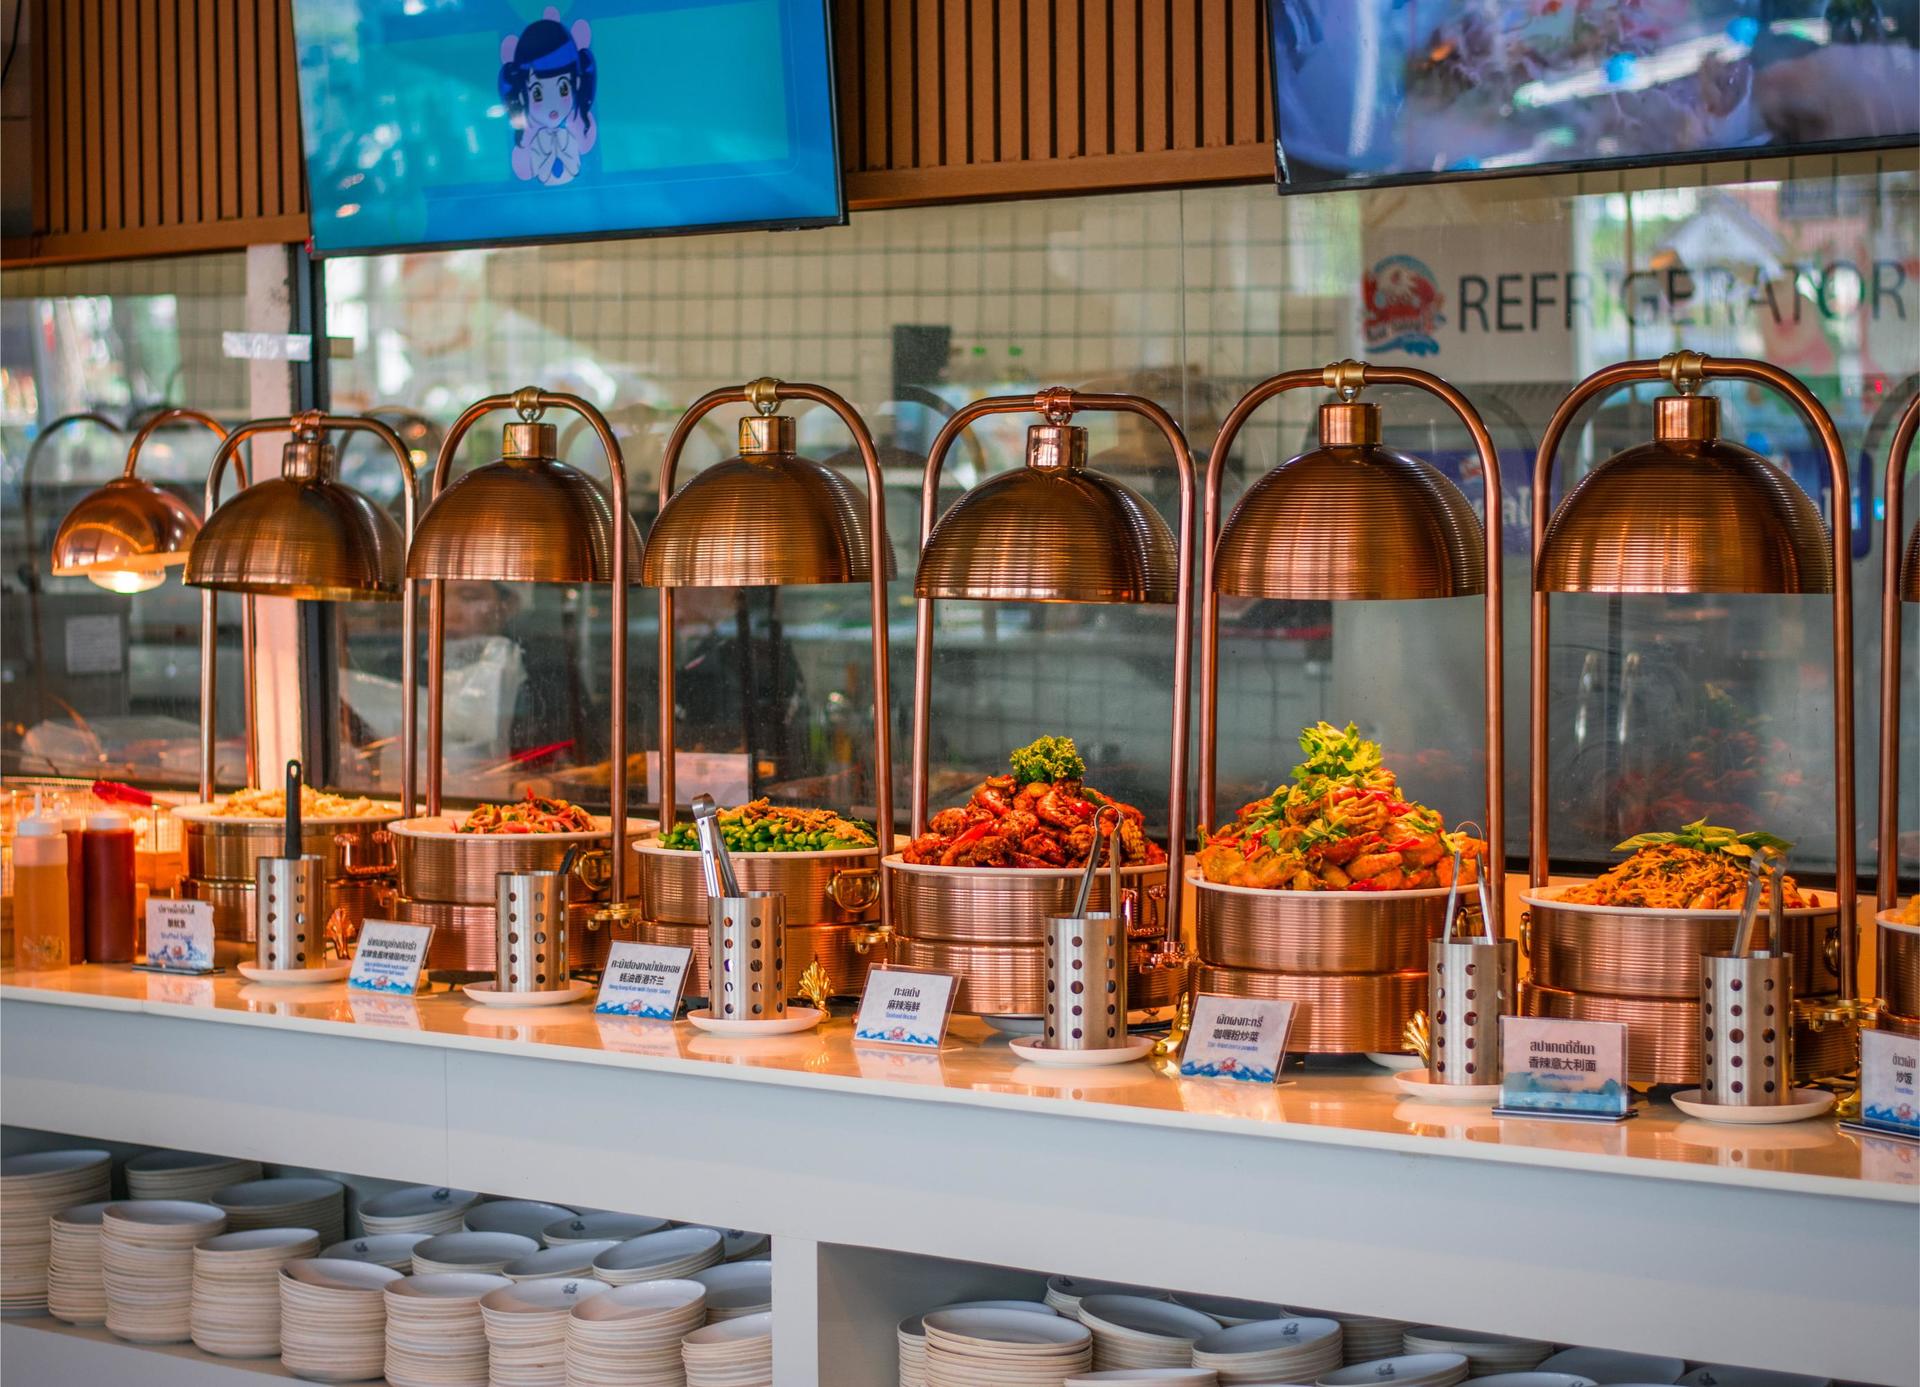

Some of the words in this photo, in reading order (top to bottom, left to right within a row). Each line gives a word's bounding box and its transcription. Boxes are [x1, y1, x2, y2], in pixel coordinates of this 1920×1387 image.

[886, 999, 921, 1012] 麻辣海鲜
[1528, 1056, 1597, 1072] 香辣意大利面
